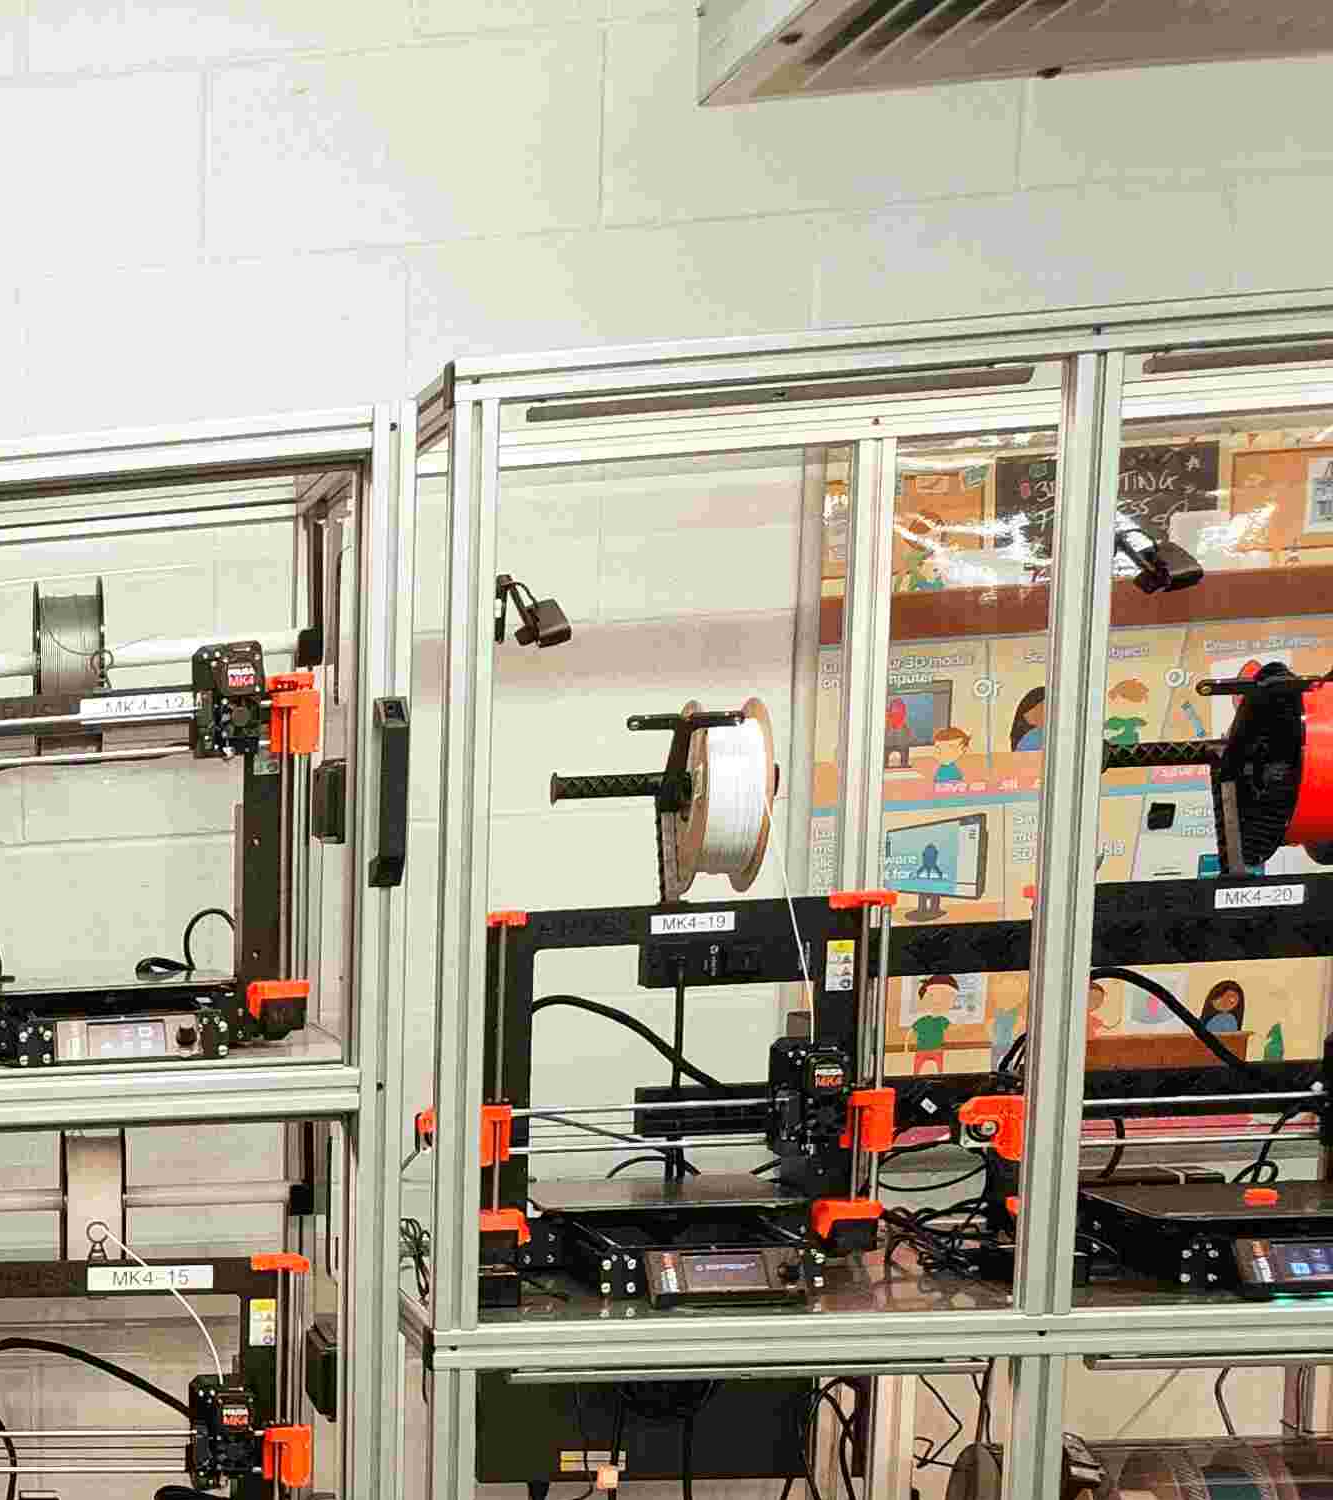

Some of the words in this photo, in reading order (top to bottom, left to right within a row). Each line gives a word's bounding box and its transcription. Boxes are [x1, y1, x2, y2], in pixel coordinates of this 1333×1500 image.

[972, 678, 1004, 702] Or
[1224, 886, 1294, 906] MK4-20
[661, 914, 726, 932] MK4-19
[112, 1266, 190, 1288] MK4-15
